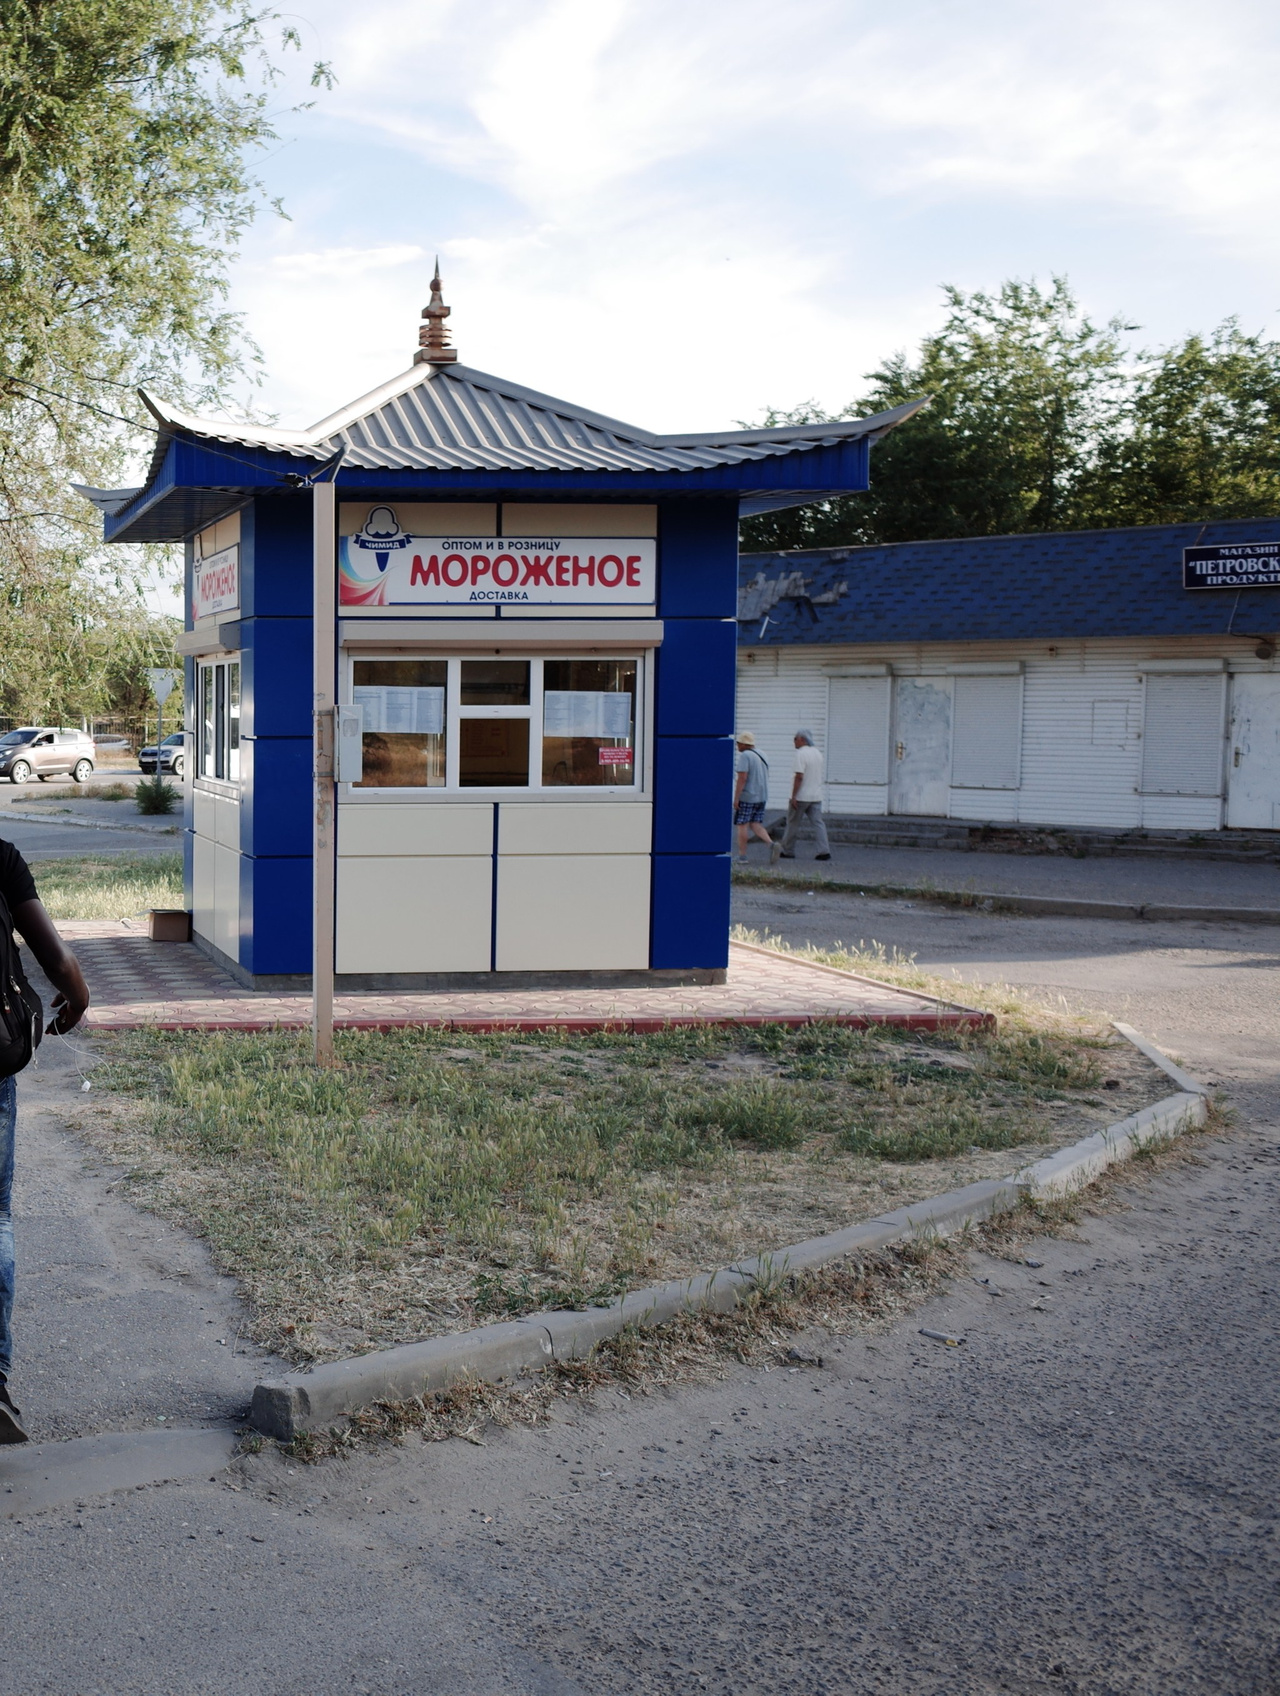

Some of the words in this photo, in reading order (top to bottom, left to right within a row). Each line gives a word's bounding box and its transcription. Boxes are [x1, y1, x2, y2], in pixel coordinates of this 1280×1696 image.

[365, 541, 400, 549] ЧИМИД
[442, 541, 482, 550] ОПТОМ
[486, 541, 494, 550] И
[498, 541, 504, 550] В
[508, 541, 561, 551] РОЗНИЦУ
[1220, 546, 1278, 555] МАГАЗИН
[410, 554, 641, 587] МОРОЖЕНОЕ
[469, 591, 529, 600] ДОСТАВКА
